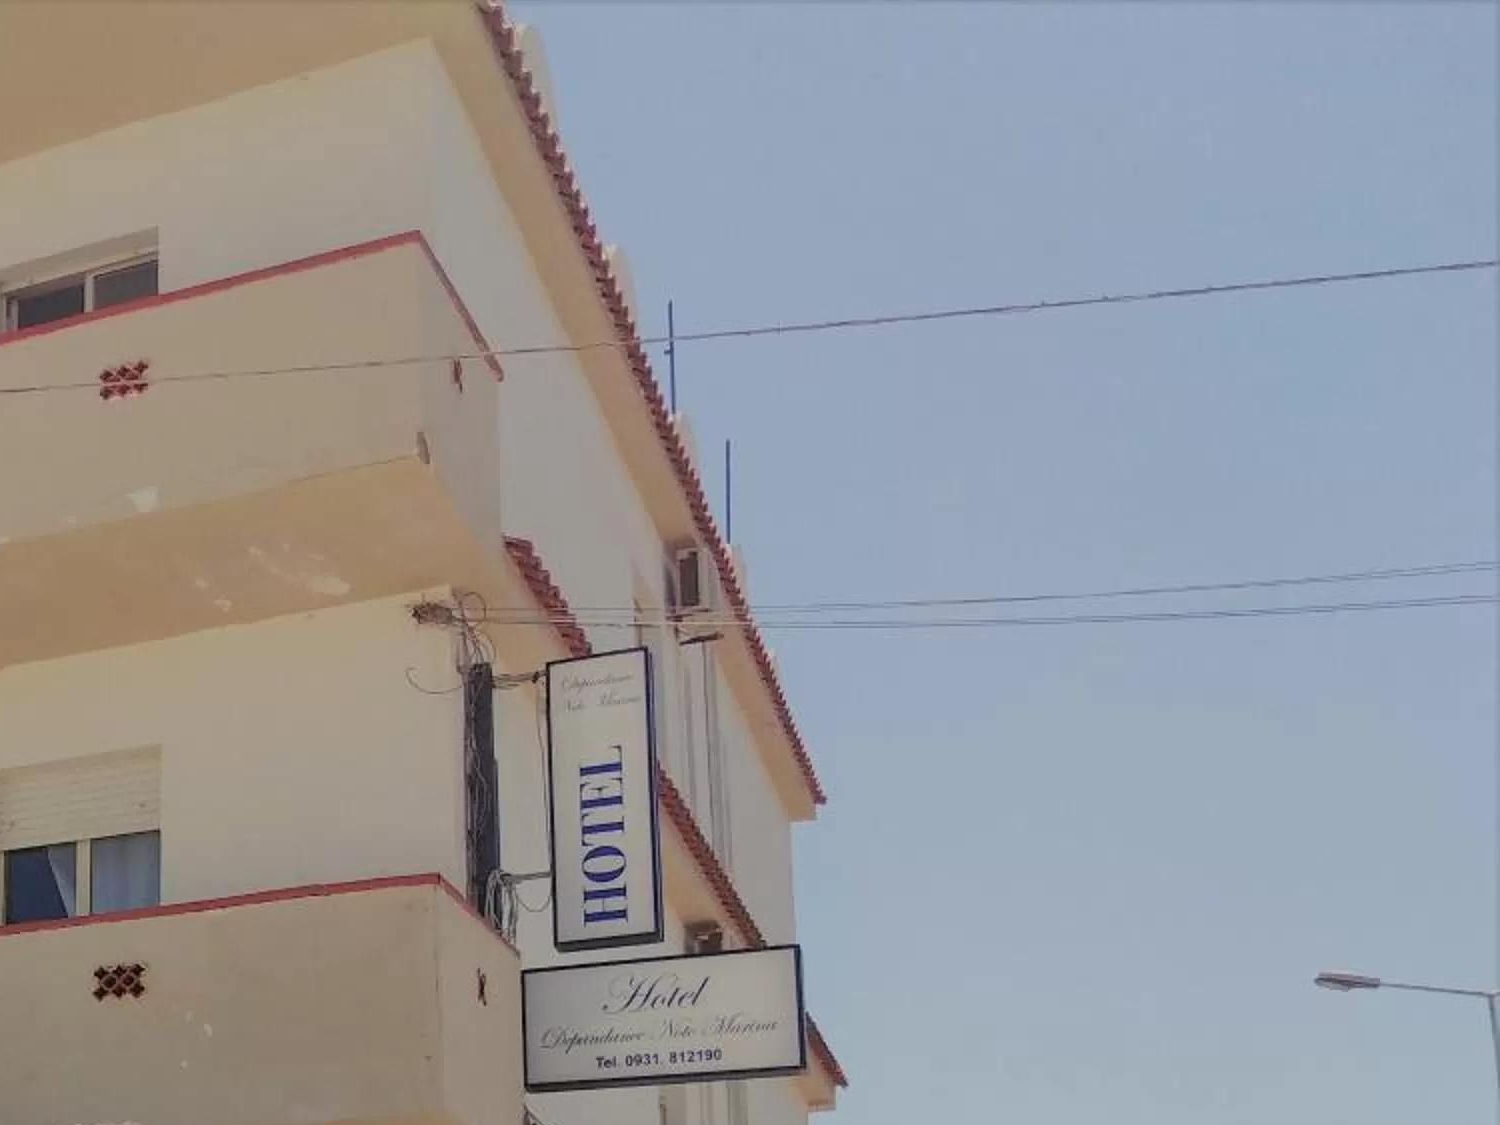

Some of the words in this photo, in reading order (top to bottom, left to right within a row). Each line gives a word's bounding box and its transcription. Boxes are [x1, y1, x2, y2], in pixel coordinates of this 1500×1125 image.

[579, 745, 628, 927] HOTEL
[602, 972, 712, 1014] Hotel
[669, 1048, 723, 1065] 812190
